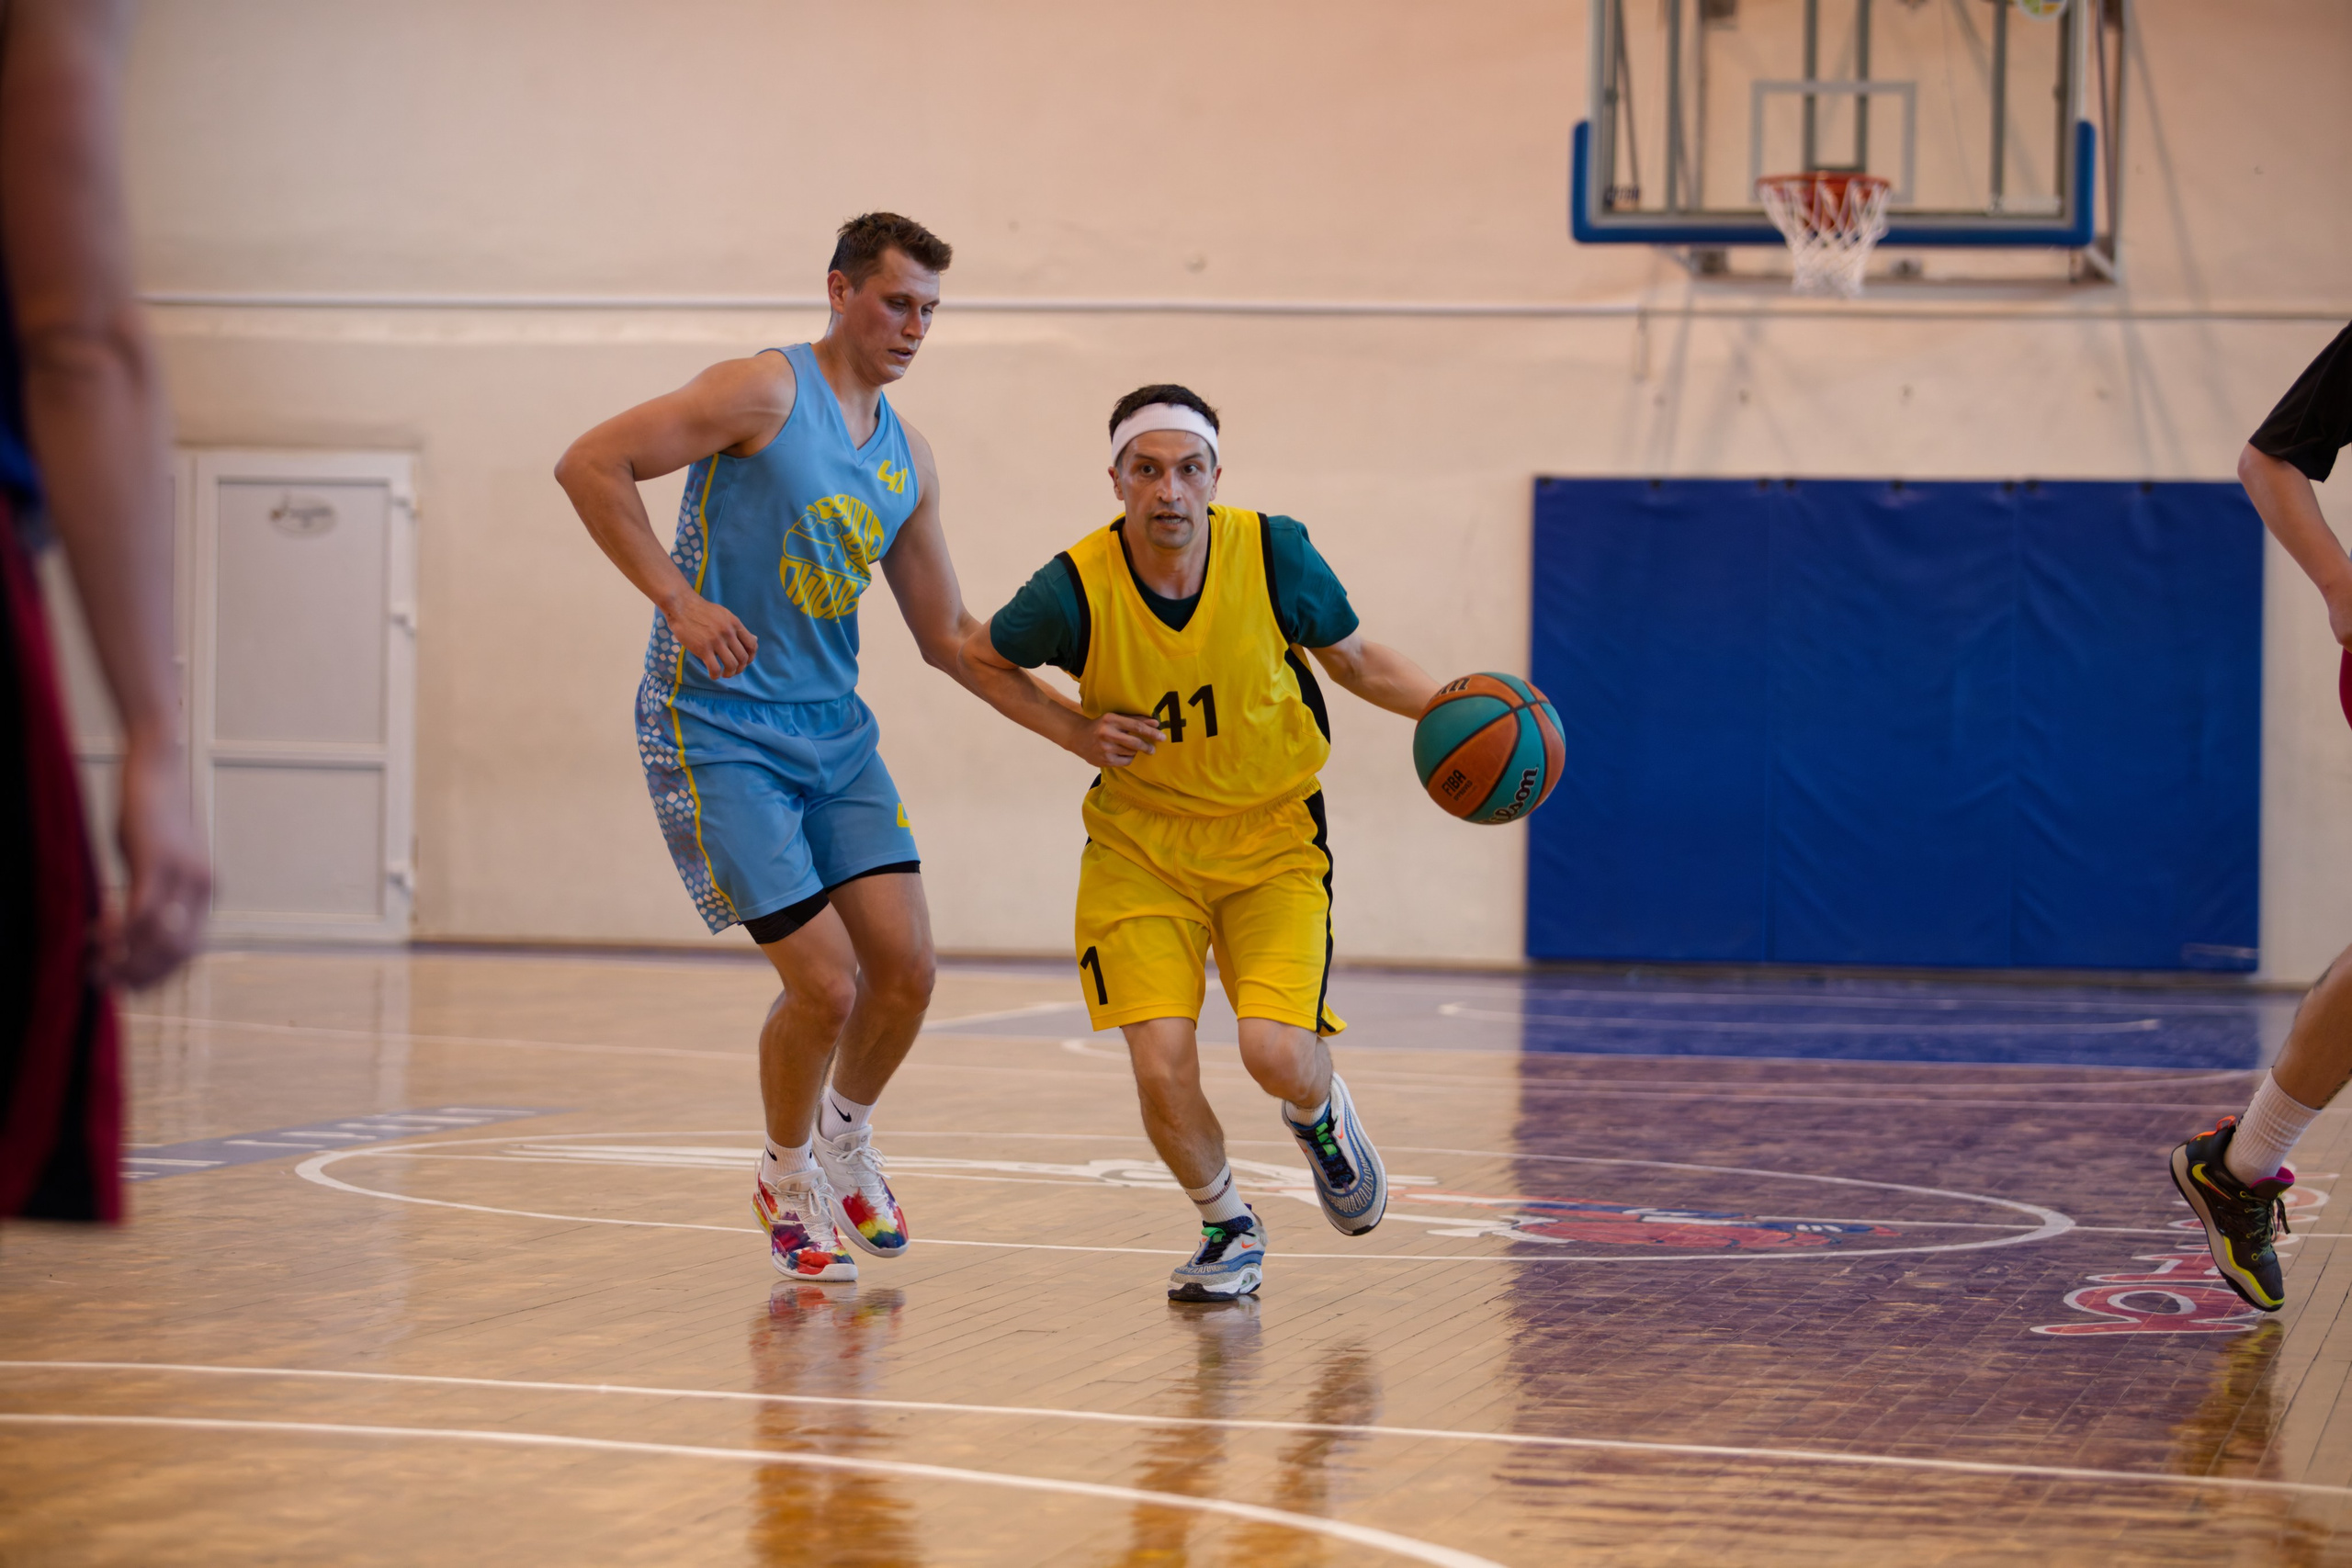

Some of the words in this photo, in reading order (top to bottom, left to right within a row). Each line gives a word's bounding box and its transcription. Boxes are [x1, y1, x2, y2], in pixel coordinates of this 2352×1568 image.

[877, 459, 908, 494] 41
[1151, 683, 1218, 743] 41
[1442, 769, 1467, 796] FIBA
[1080, 945, 1109, 1006] 1
